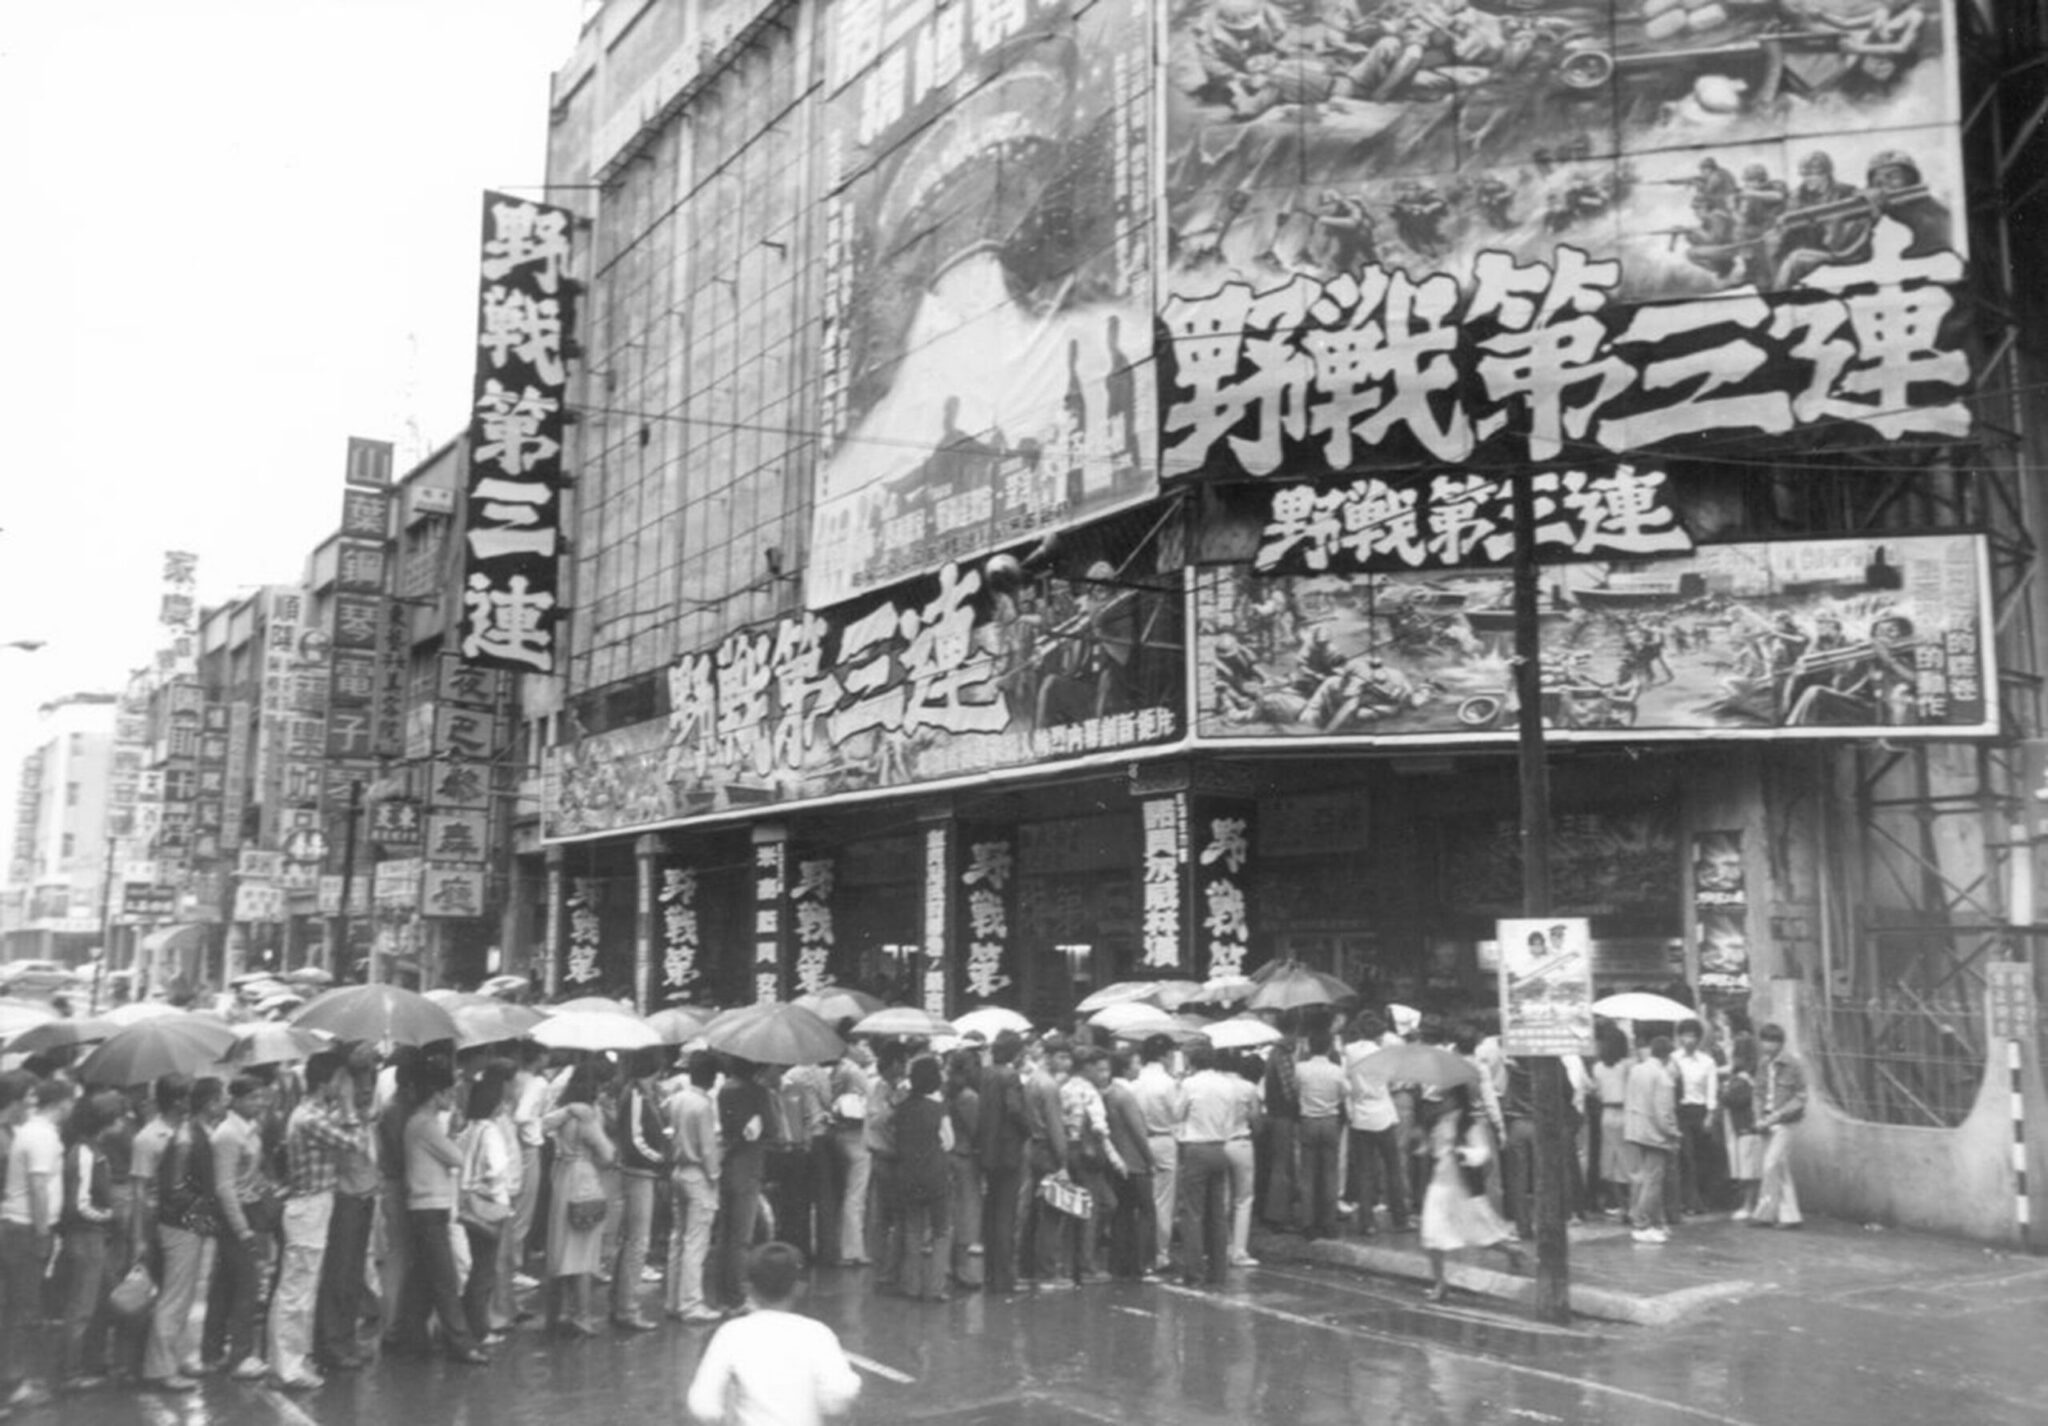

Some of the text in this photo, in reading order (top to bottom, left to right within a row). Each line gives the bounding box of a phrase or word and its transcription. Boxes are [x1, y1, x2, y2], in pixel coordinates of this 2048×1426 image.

[462, 200, 570, 672] 野戰第三連
[1160, 217, 1972, 478] 野戰第三連
[1253, 463, 1693, 572] 野戰第三連
[666, 561, 1012, 781] 野戰第三連
